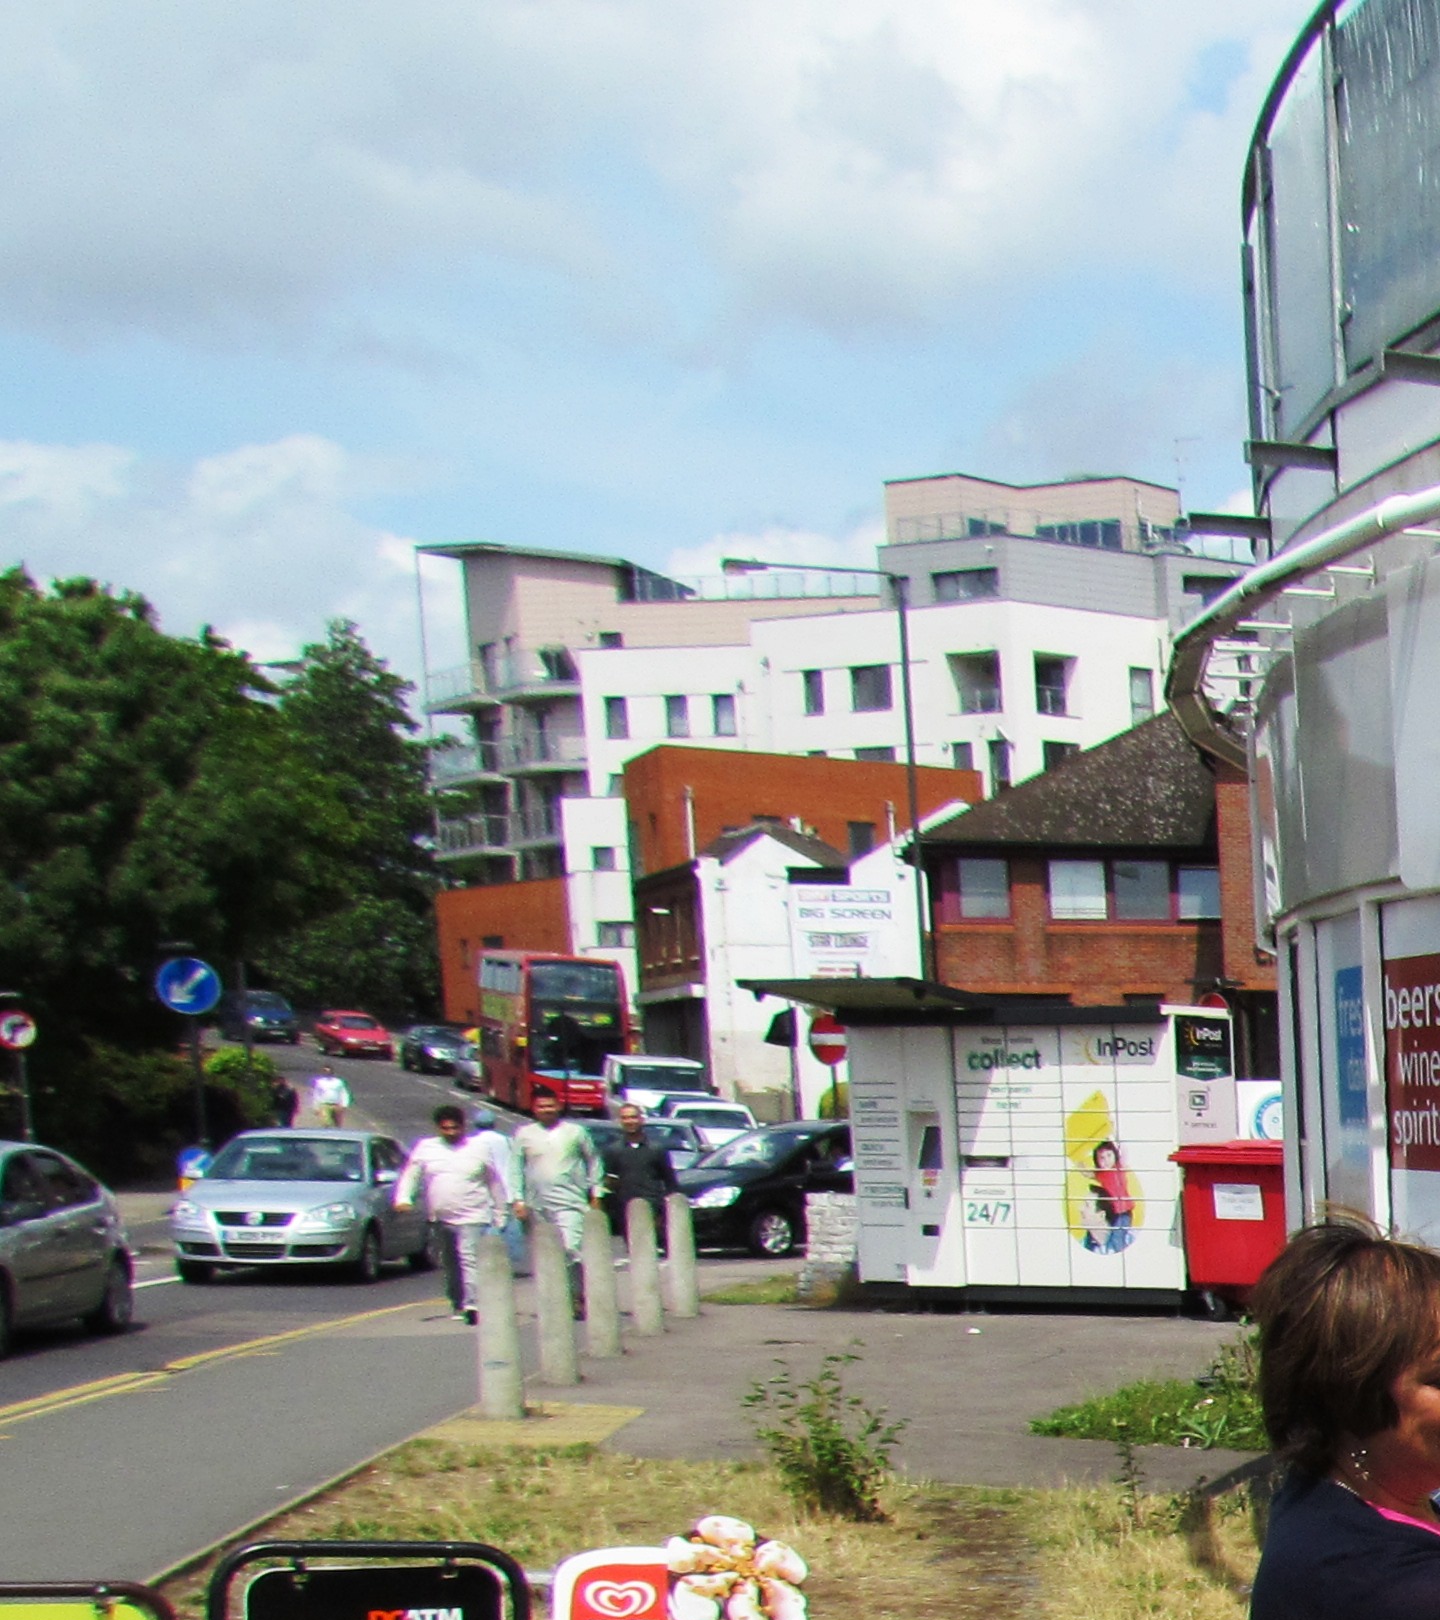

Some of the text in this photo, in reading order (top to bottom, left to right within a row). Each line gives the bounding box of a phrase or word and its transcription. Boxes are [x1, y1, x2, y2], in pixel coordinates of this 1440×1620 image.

[800, 907, 892, 920] BIG SCREEN
[1196, 1028, 1223, 1042] InPost
[1097, 1037, 1155, 1058] InPost
[967, 1049, 1042, 1071] collect
[967, 1202, 1011, 1225] 24/7
